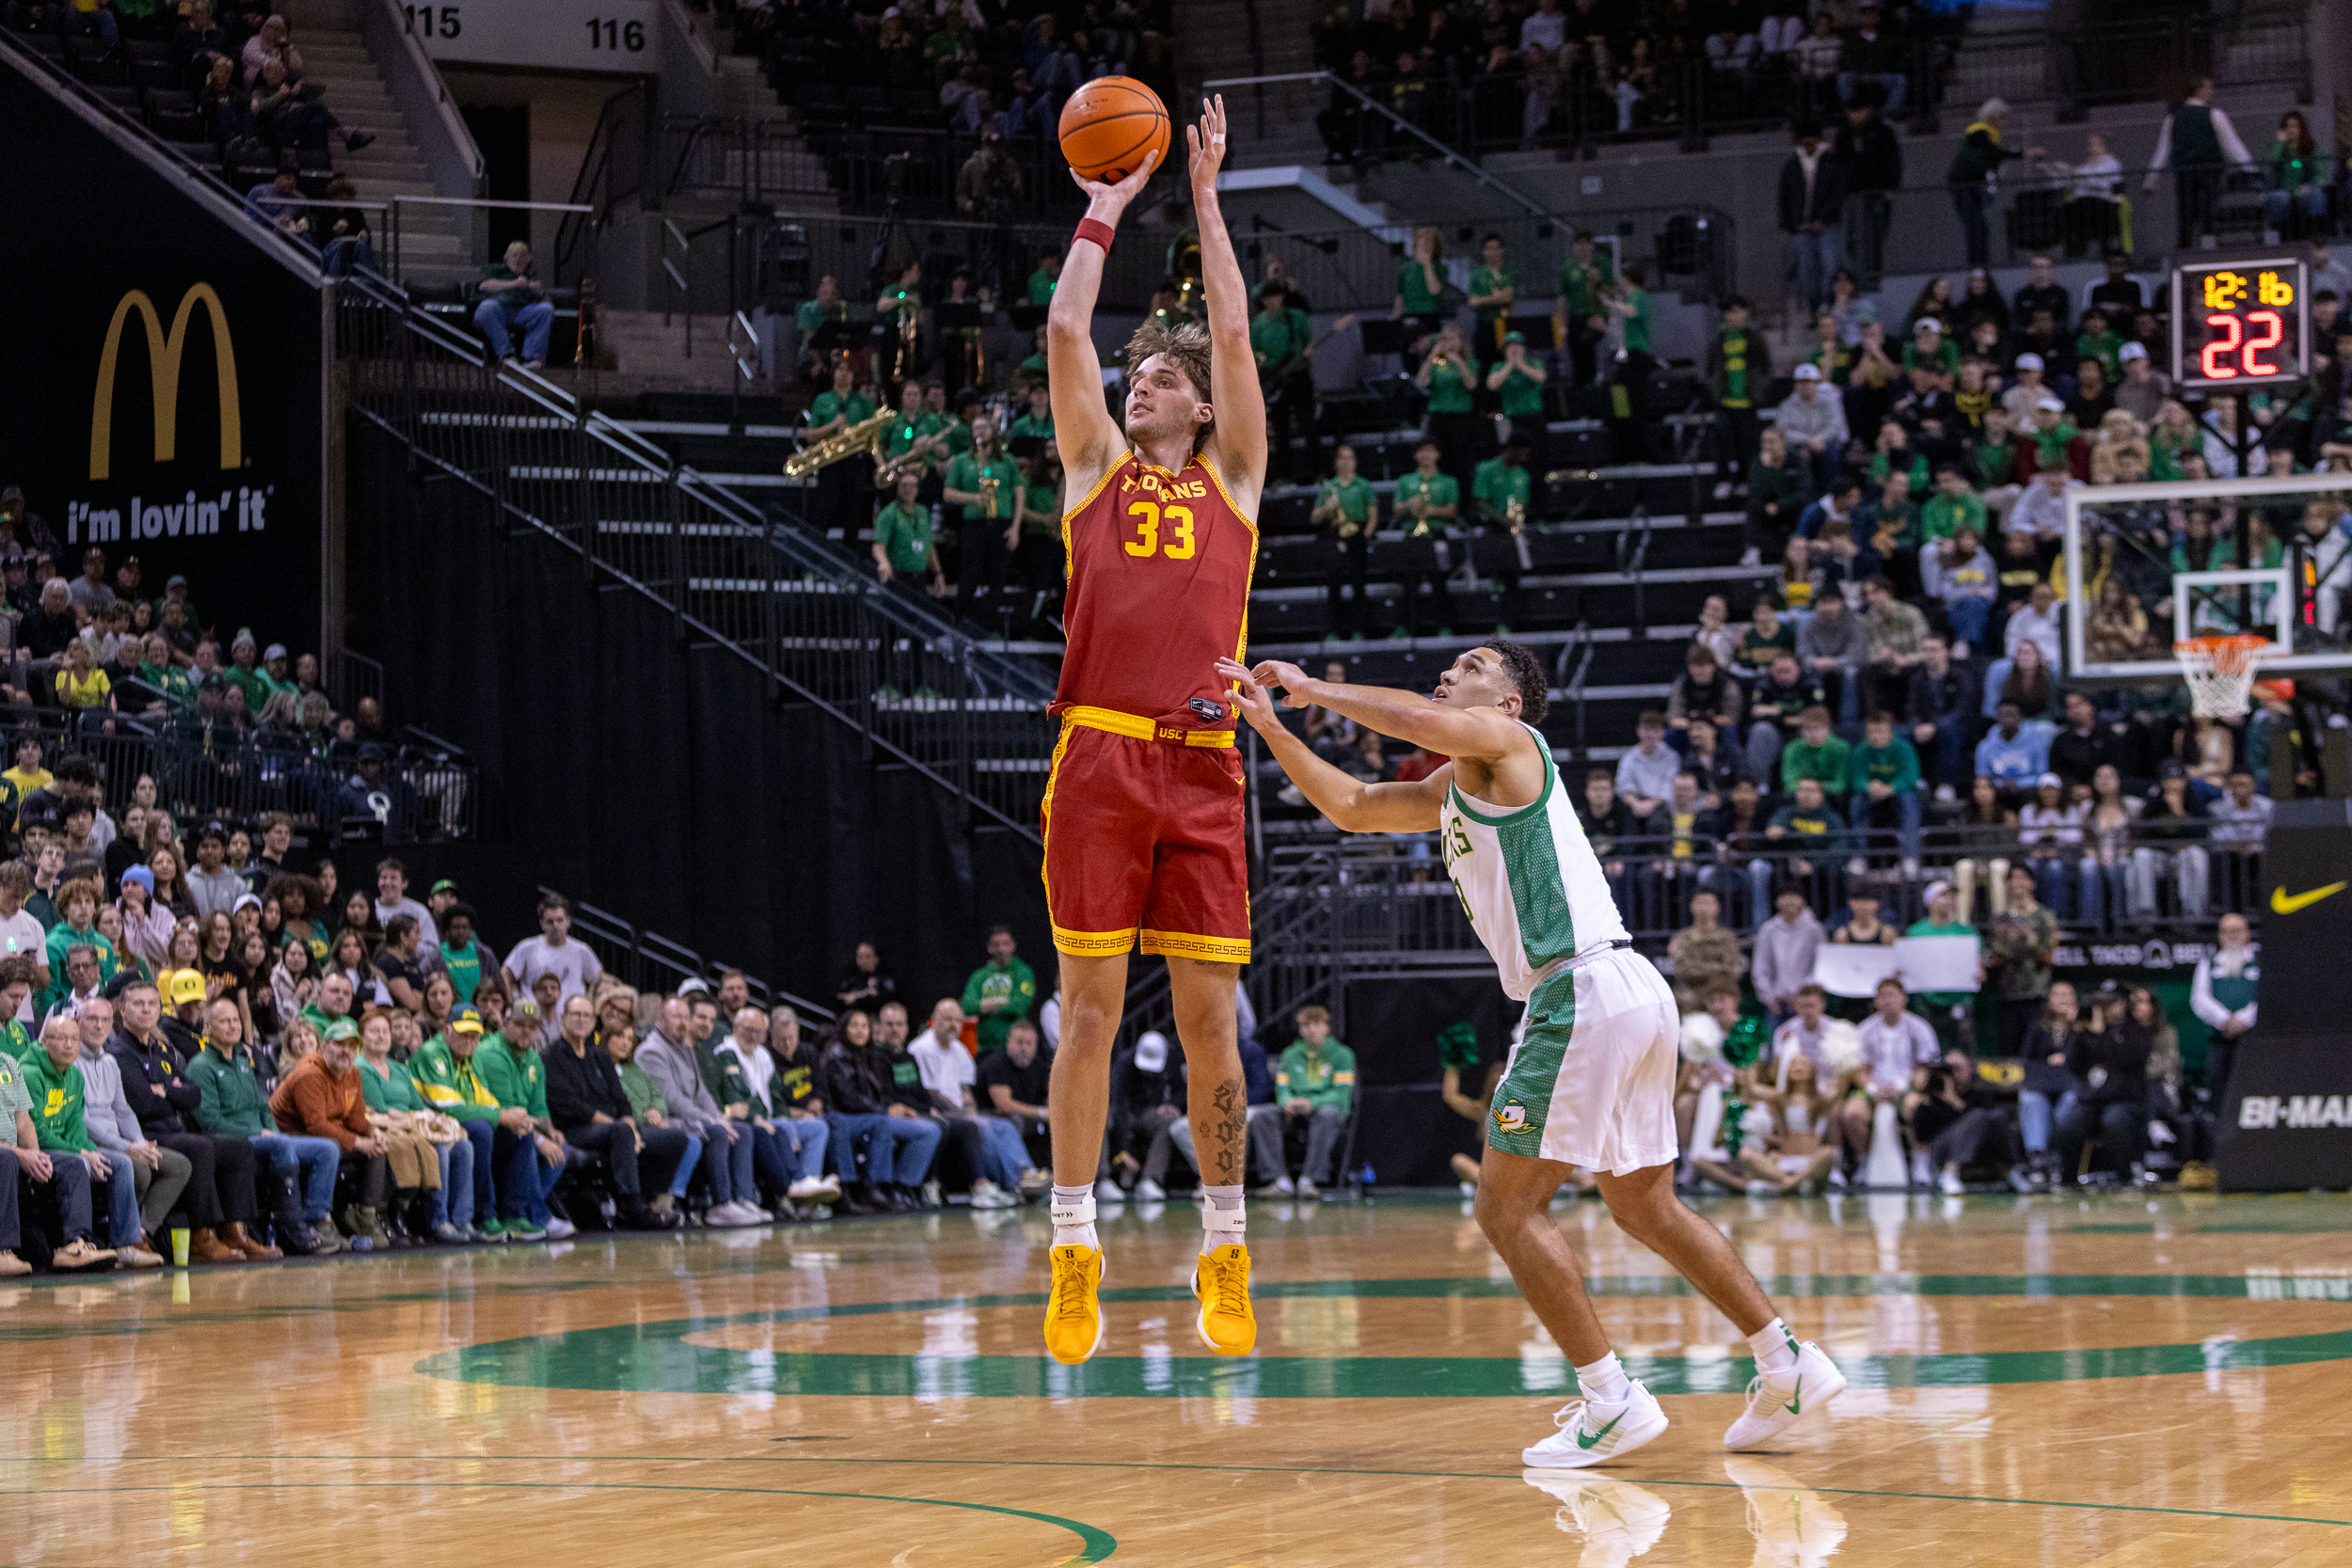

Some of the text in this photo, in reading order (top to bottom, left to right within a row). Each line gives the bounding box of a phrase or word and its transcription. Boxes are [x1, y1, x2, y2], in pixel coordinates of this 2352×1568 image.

[405, 5, 461, 39] 115
[585, 17, 645, 52] 116
[2204, 271, 2294, 310] 12:16
[2201, 309, 2283, 380] 22
[68, 484, 265, 545] i'm lovin' it
[1124, 501, 1196, 560] 33
[1159, 727, 1183, 739] USC
